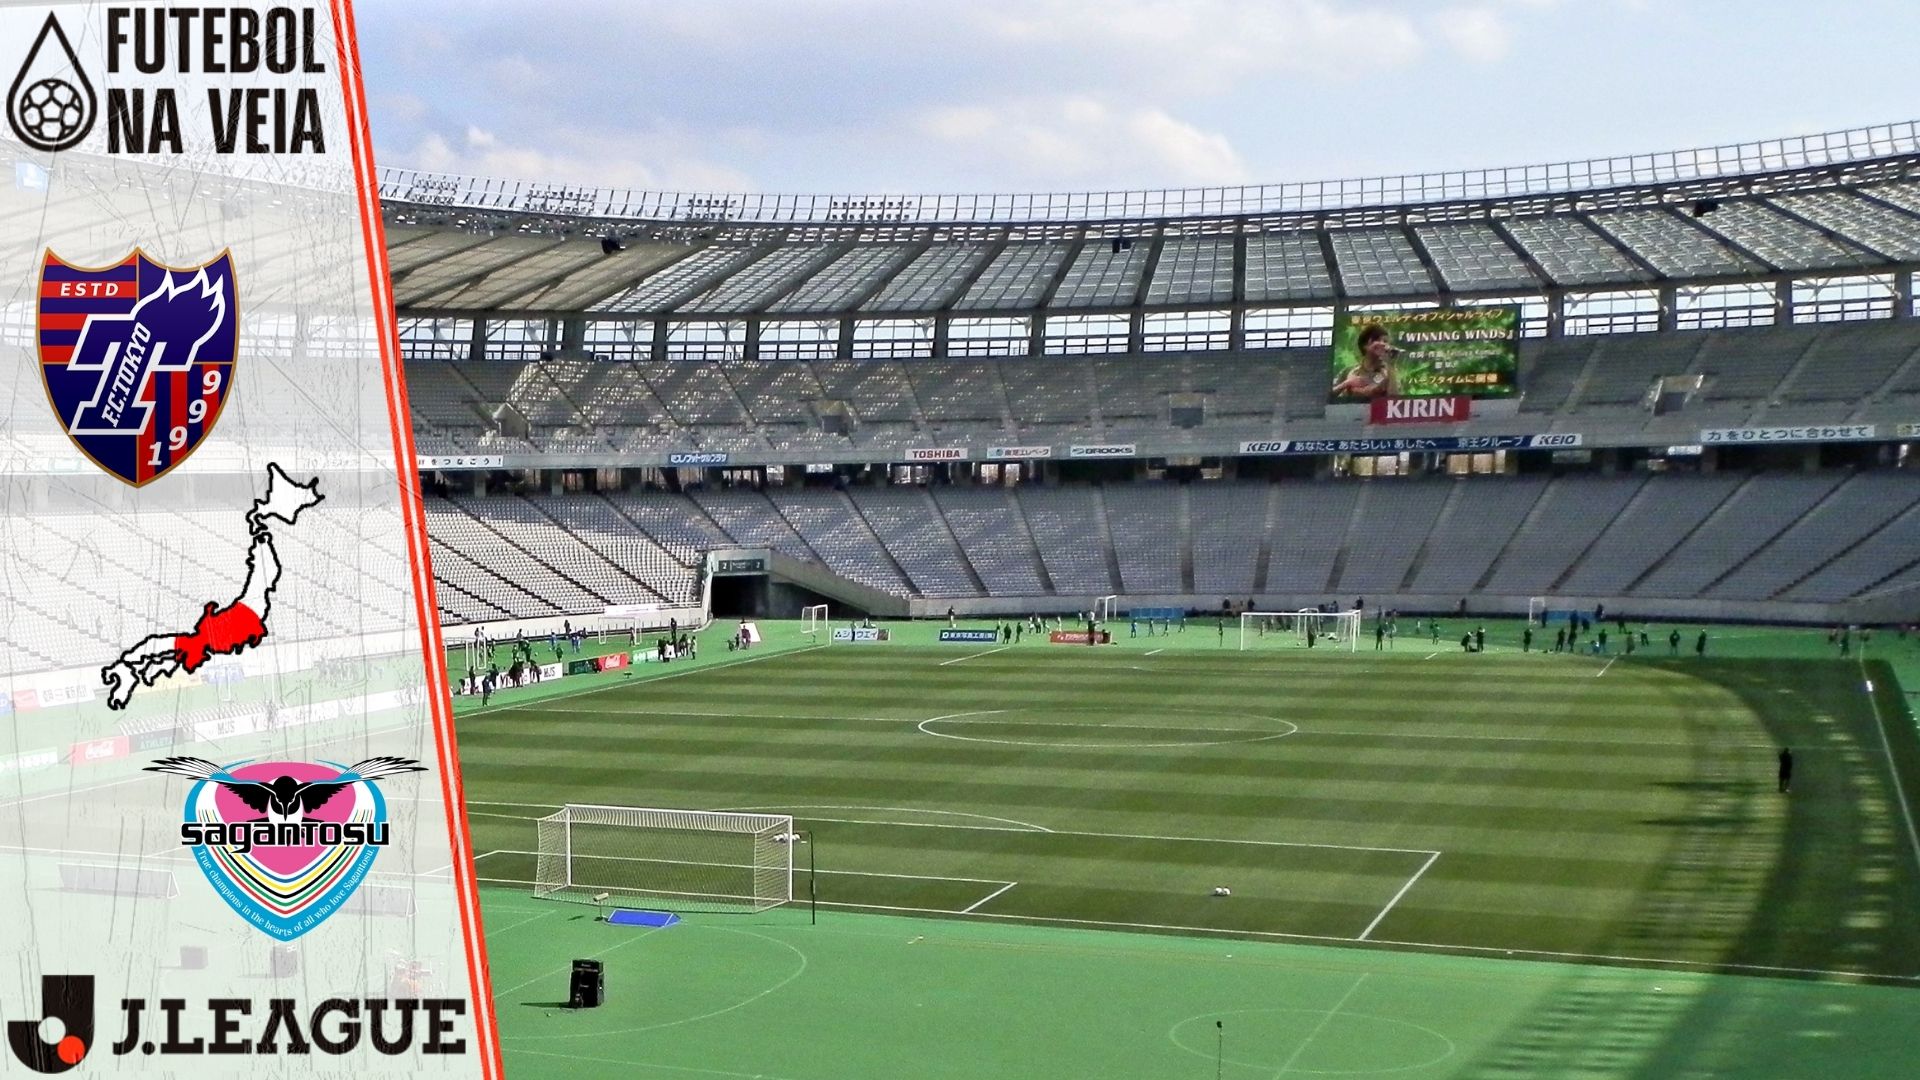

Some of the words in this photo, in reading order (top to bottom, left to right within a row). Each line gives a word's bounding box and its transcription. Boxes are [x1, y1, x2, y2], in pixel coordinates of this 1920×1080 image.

[1387, 397, 1455, 419] KIRIN
[1707, 426, 1868, 440] 力をひとつに合わせて
[1246, 442, 1282, 452] KEIO
[1294, 442, 1335, 451] あなたと
[1338, 440, 1391, 450] あたらしい
[1539, 435, 1576, 445] KEIO
[912, 450, 960, 459] TOSHIBA
[1085, 447, 1133, 455] BROOKS
